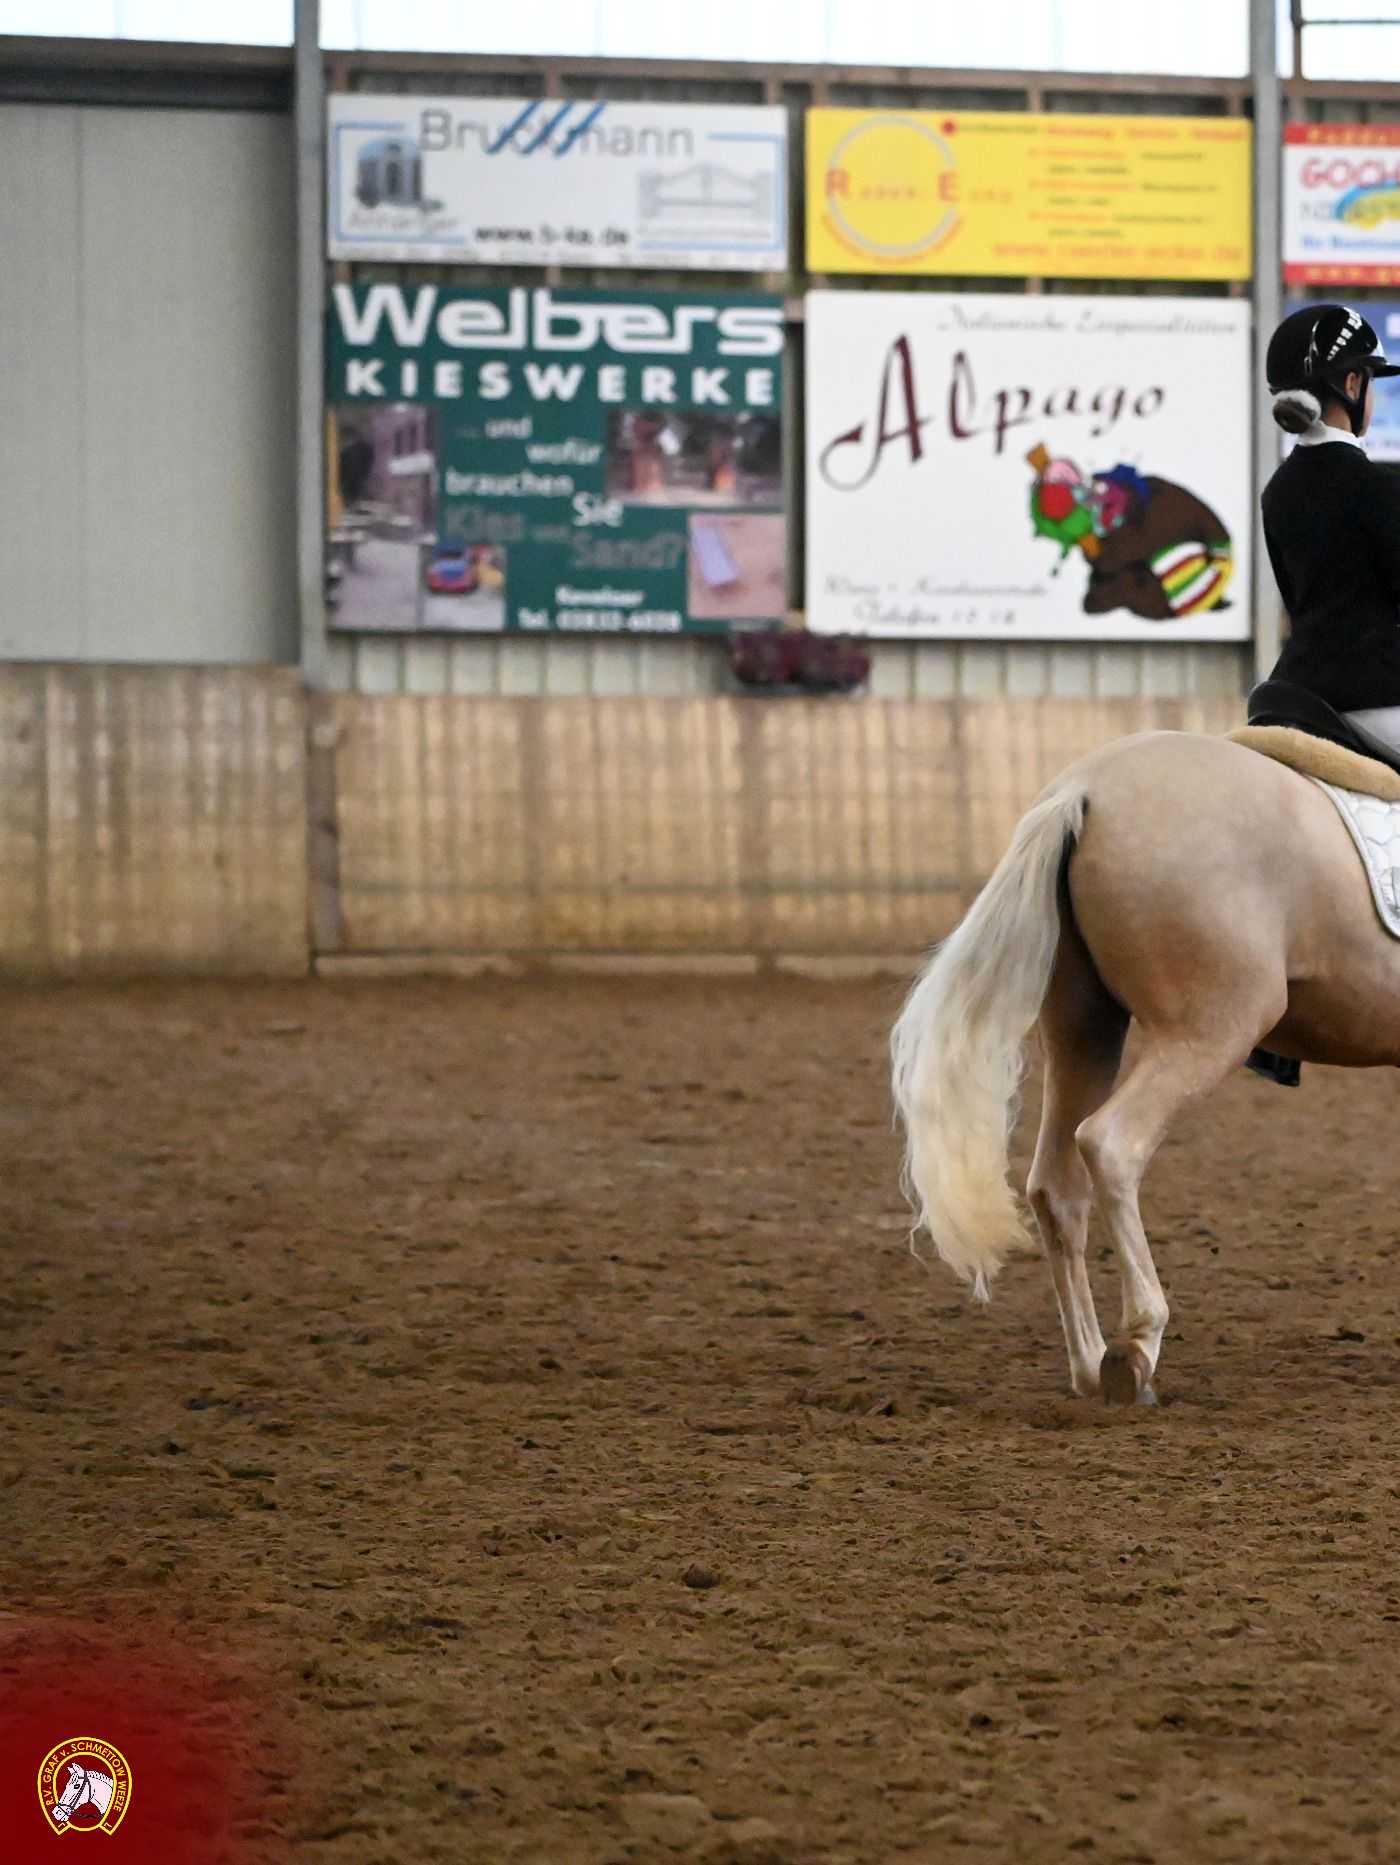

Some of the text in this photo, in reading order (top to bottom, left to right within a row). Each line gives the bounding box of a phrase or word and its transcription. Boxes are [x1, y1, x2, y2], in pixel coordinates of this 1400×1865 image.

[331, 282, 786, 356] Welbers
[345, 359, 776, 405] KIESWERKE
[485, 416, 533, 440] und
[819, 333, 1166, 492] Alpago
[526, 438, 604, 466] wofür
[445, 467, 575, 497] brauchen
[572, 491, 625, 528] Sie
